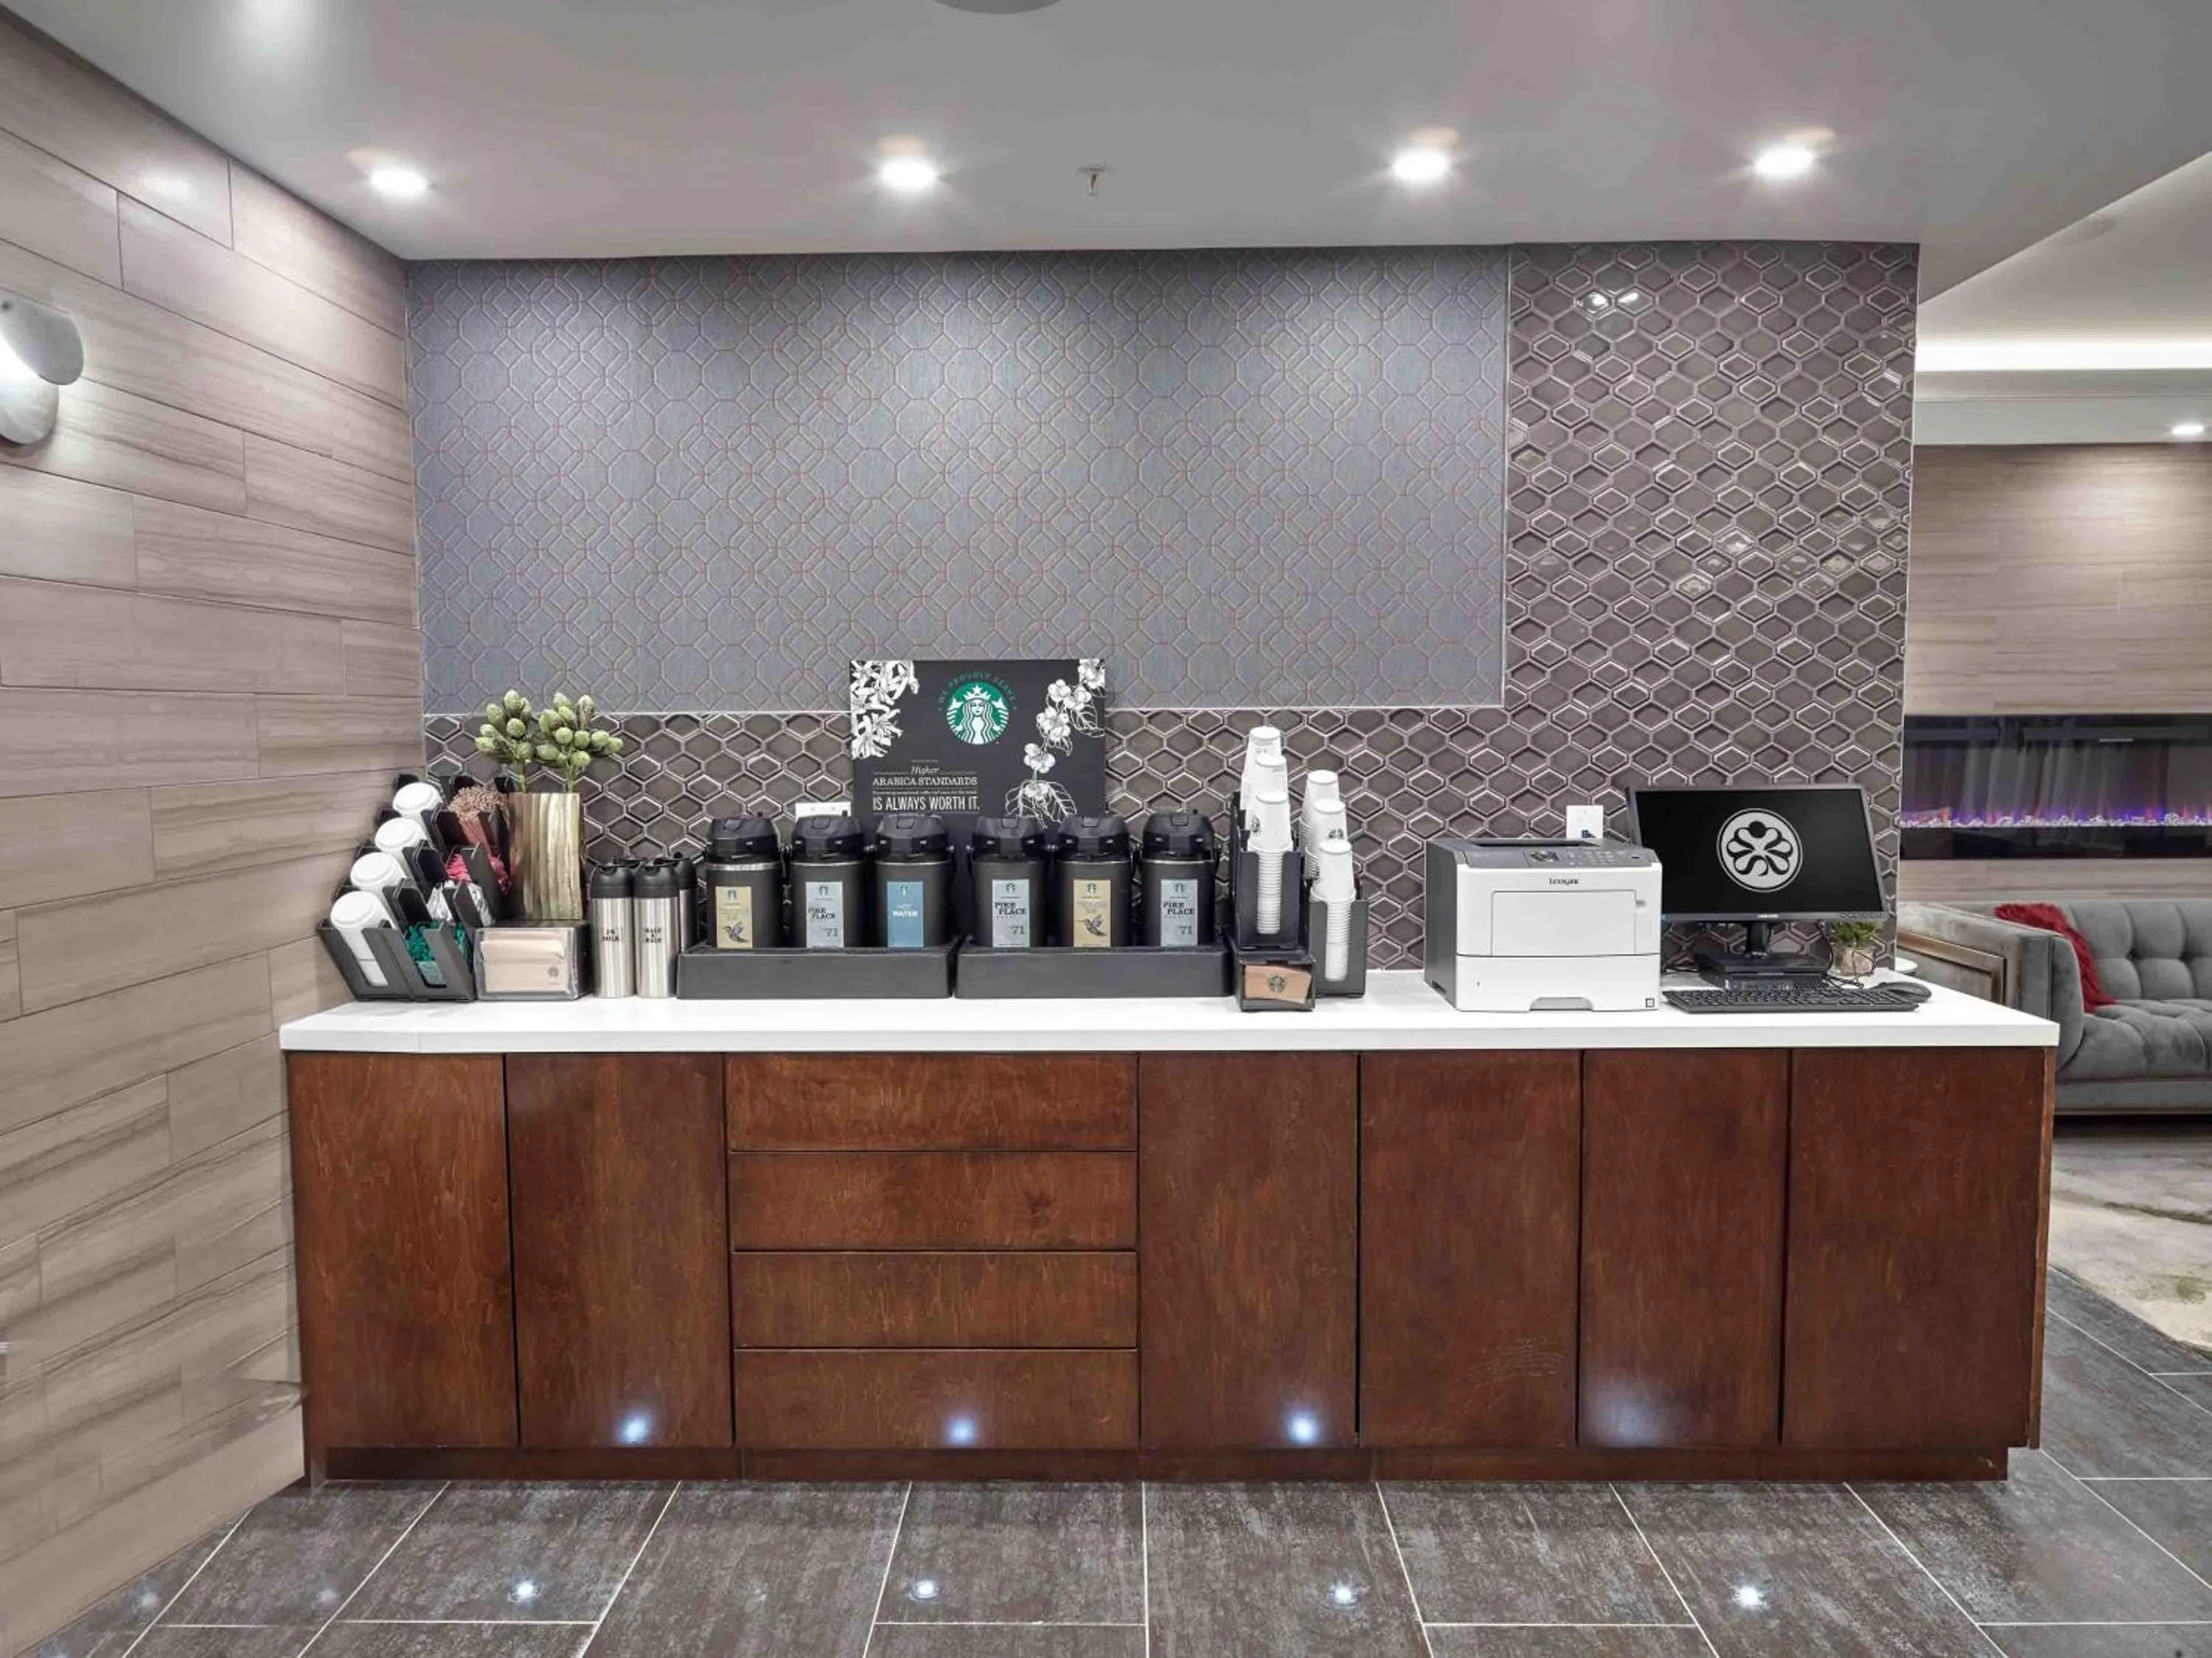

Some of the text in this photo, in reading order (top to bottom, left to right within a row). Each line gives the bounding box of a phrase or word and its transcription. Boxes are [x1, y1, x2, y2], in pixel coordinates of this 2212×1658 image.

[872, 777, 978, 785] ARABICA STANDARDS
[872, 796, 980, 811] IS ALWAYS WORTH IT.
